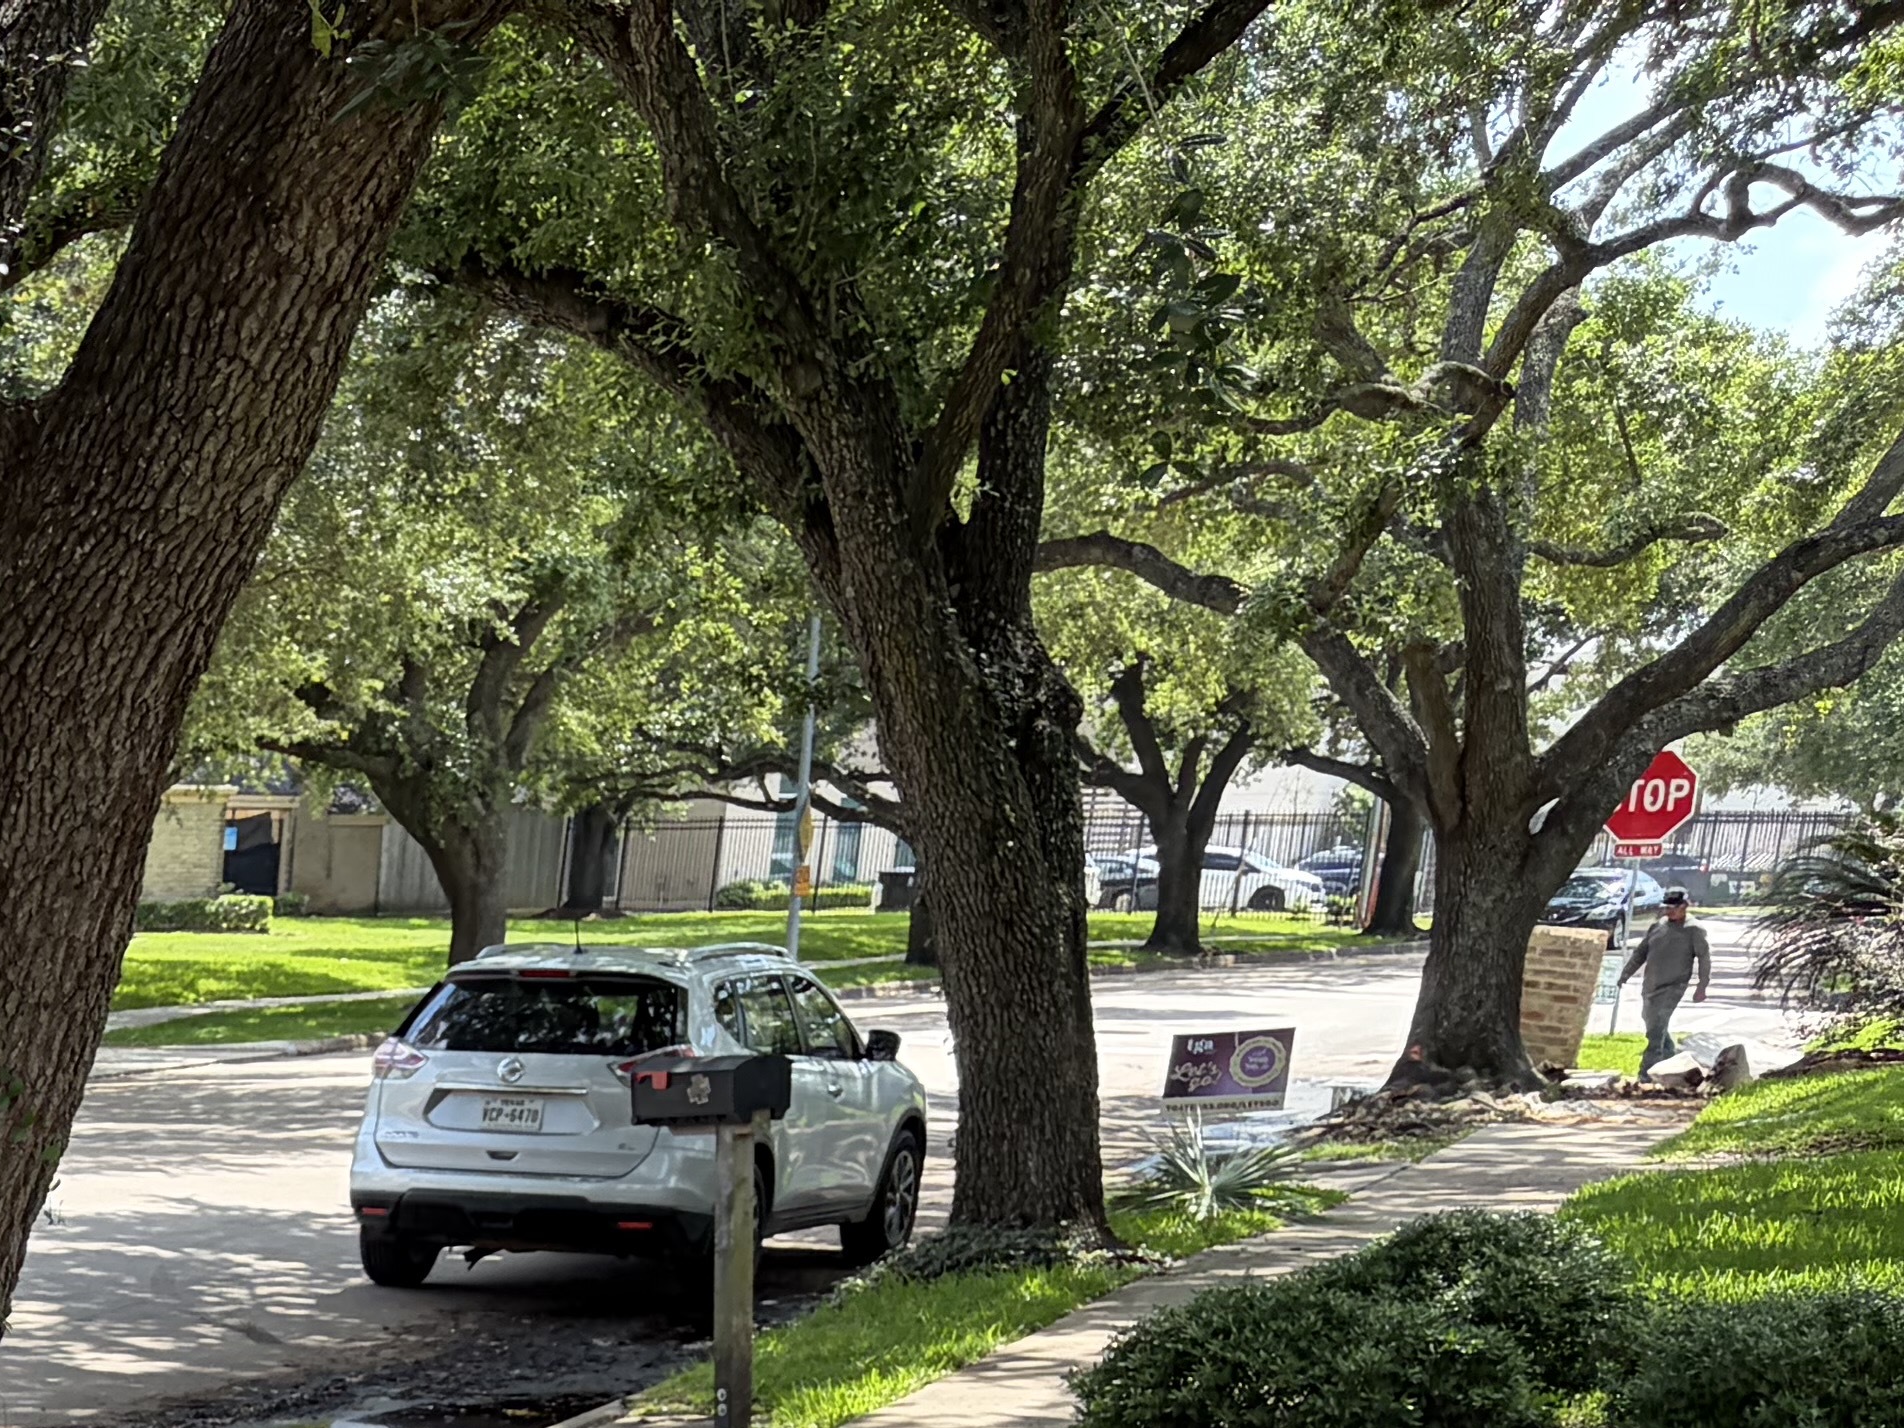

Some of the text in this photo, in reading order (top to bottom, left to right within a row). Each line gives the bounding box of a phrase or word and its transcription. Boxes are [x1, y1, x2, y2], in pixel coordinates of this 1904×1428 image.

[1613, 778, 1691, 813] TOP
[1616, 845, 1659, 856] ALL WAY
